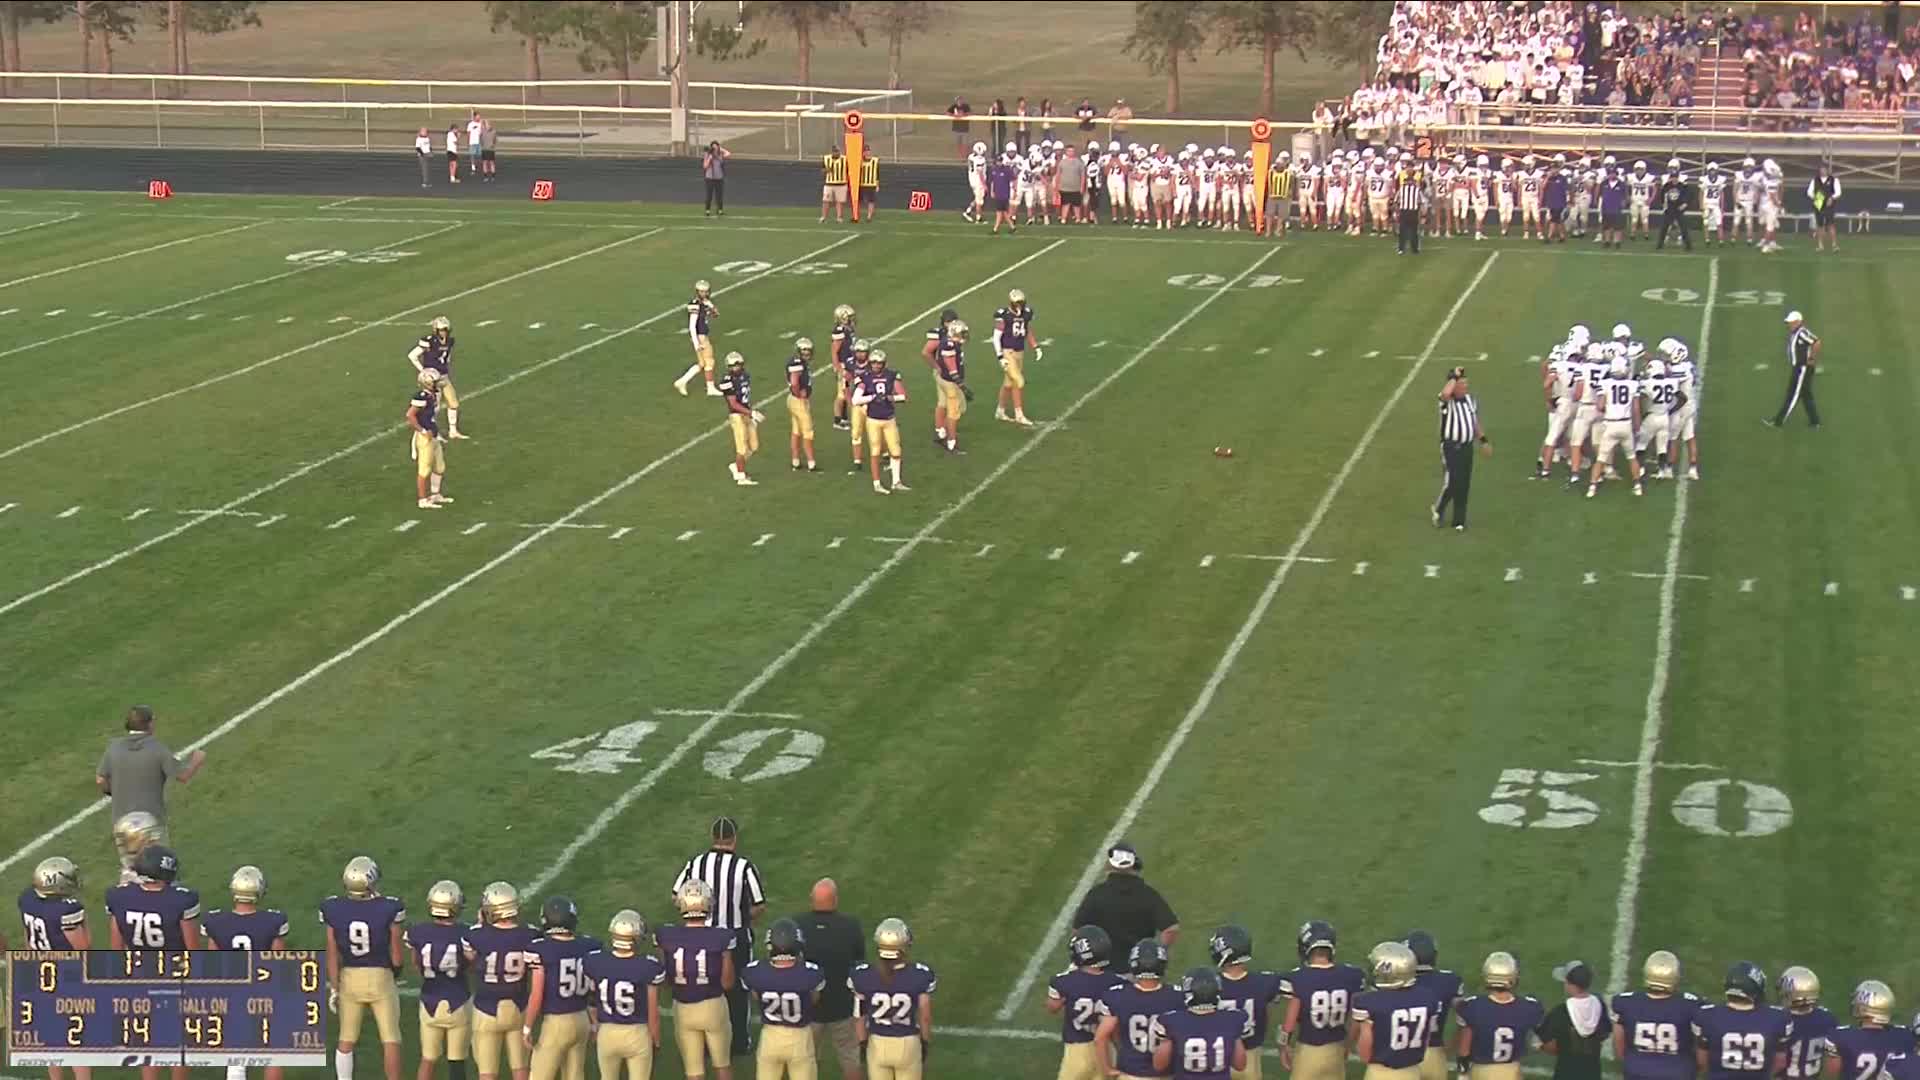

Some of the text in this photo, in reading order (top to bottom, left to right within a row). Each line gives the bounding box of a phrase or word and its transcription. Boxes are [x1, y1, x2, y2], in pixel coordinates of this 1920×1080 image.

[1416, 137, 1432, 158] 2
[534, 184, 550, 197] 20
[911, 193, 926, 208] 30
[1611, 384, 1629, 405] 18
[530, 719, 826, 783] 40
[1477, 768, 1794, 837] 50
[24, 913, 50, 949] 73
[126, 911, 165, 948] 76
[349, 921, 370, 956] 9
[421, 943, 458, 979] 14
[484, 951, 526, 983] 19
[673, 947, 709, 985] 11
[598, 977, 636, 1017] 16
[762, 992, 801, 1023] 20
[871, 993, 913, 1026] 22
[1310, 989, 1348, 1029] 88
[1390, 1006, 1427, 1050] 67
[1493, 1027, 1514, 1062] 6
[1634, 1023, 1677, 1055] 58
[1184, 1036, 1224, 1072] 81
[1721, 1032, 1764, 1070] 63
[1787, 1036, 1825, 1077] 15
